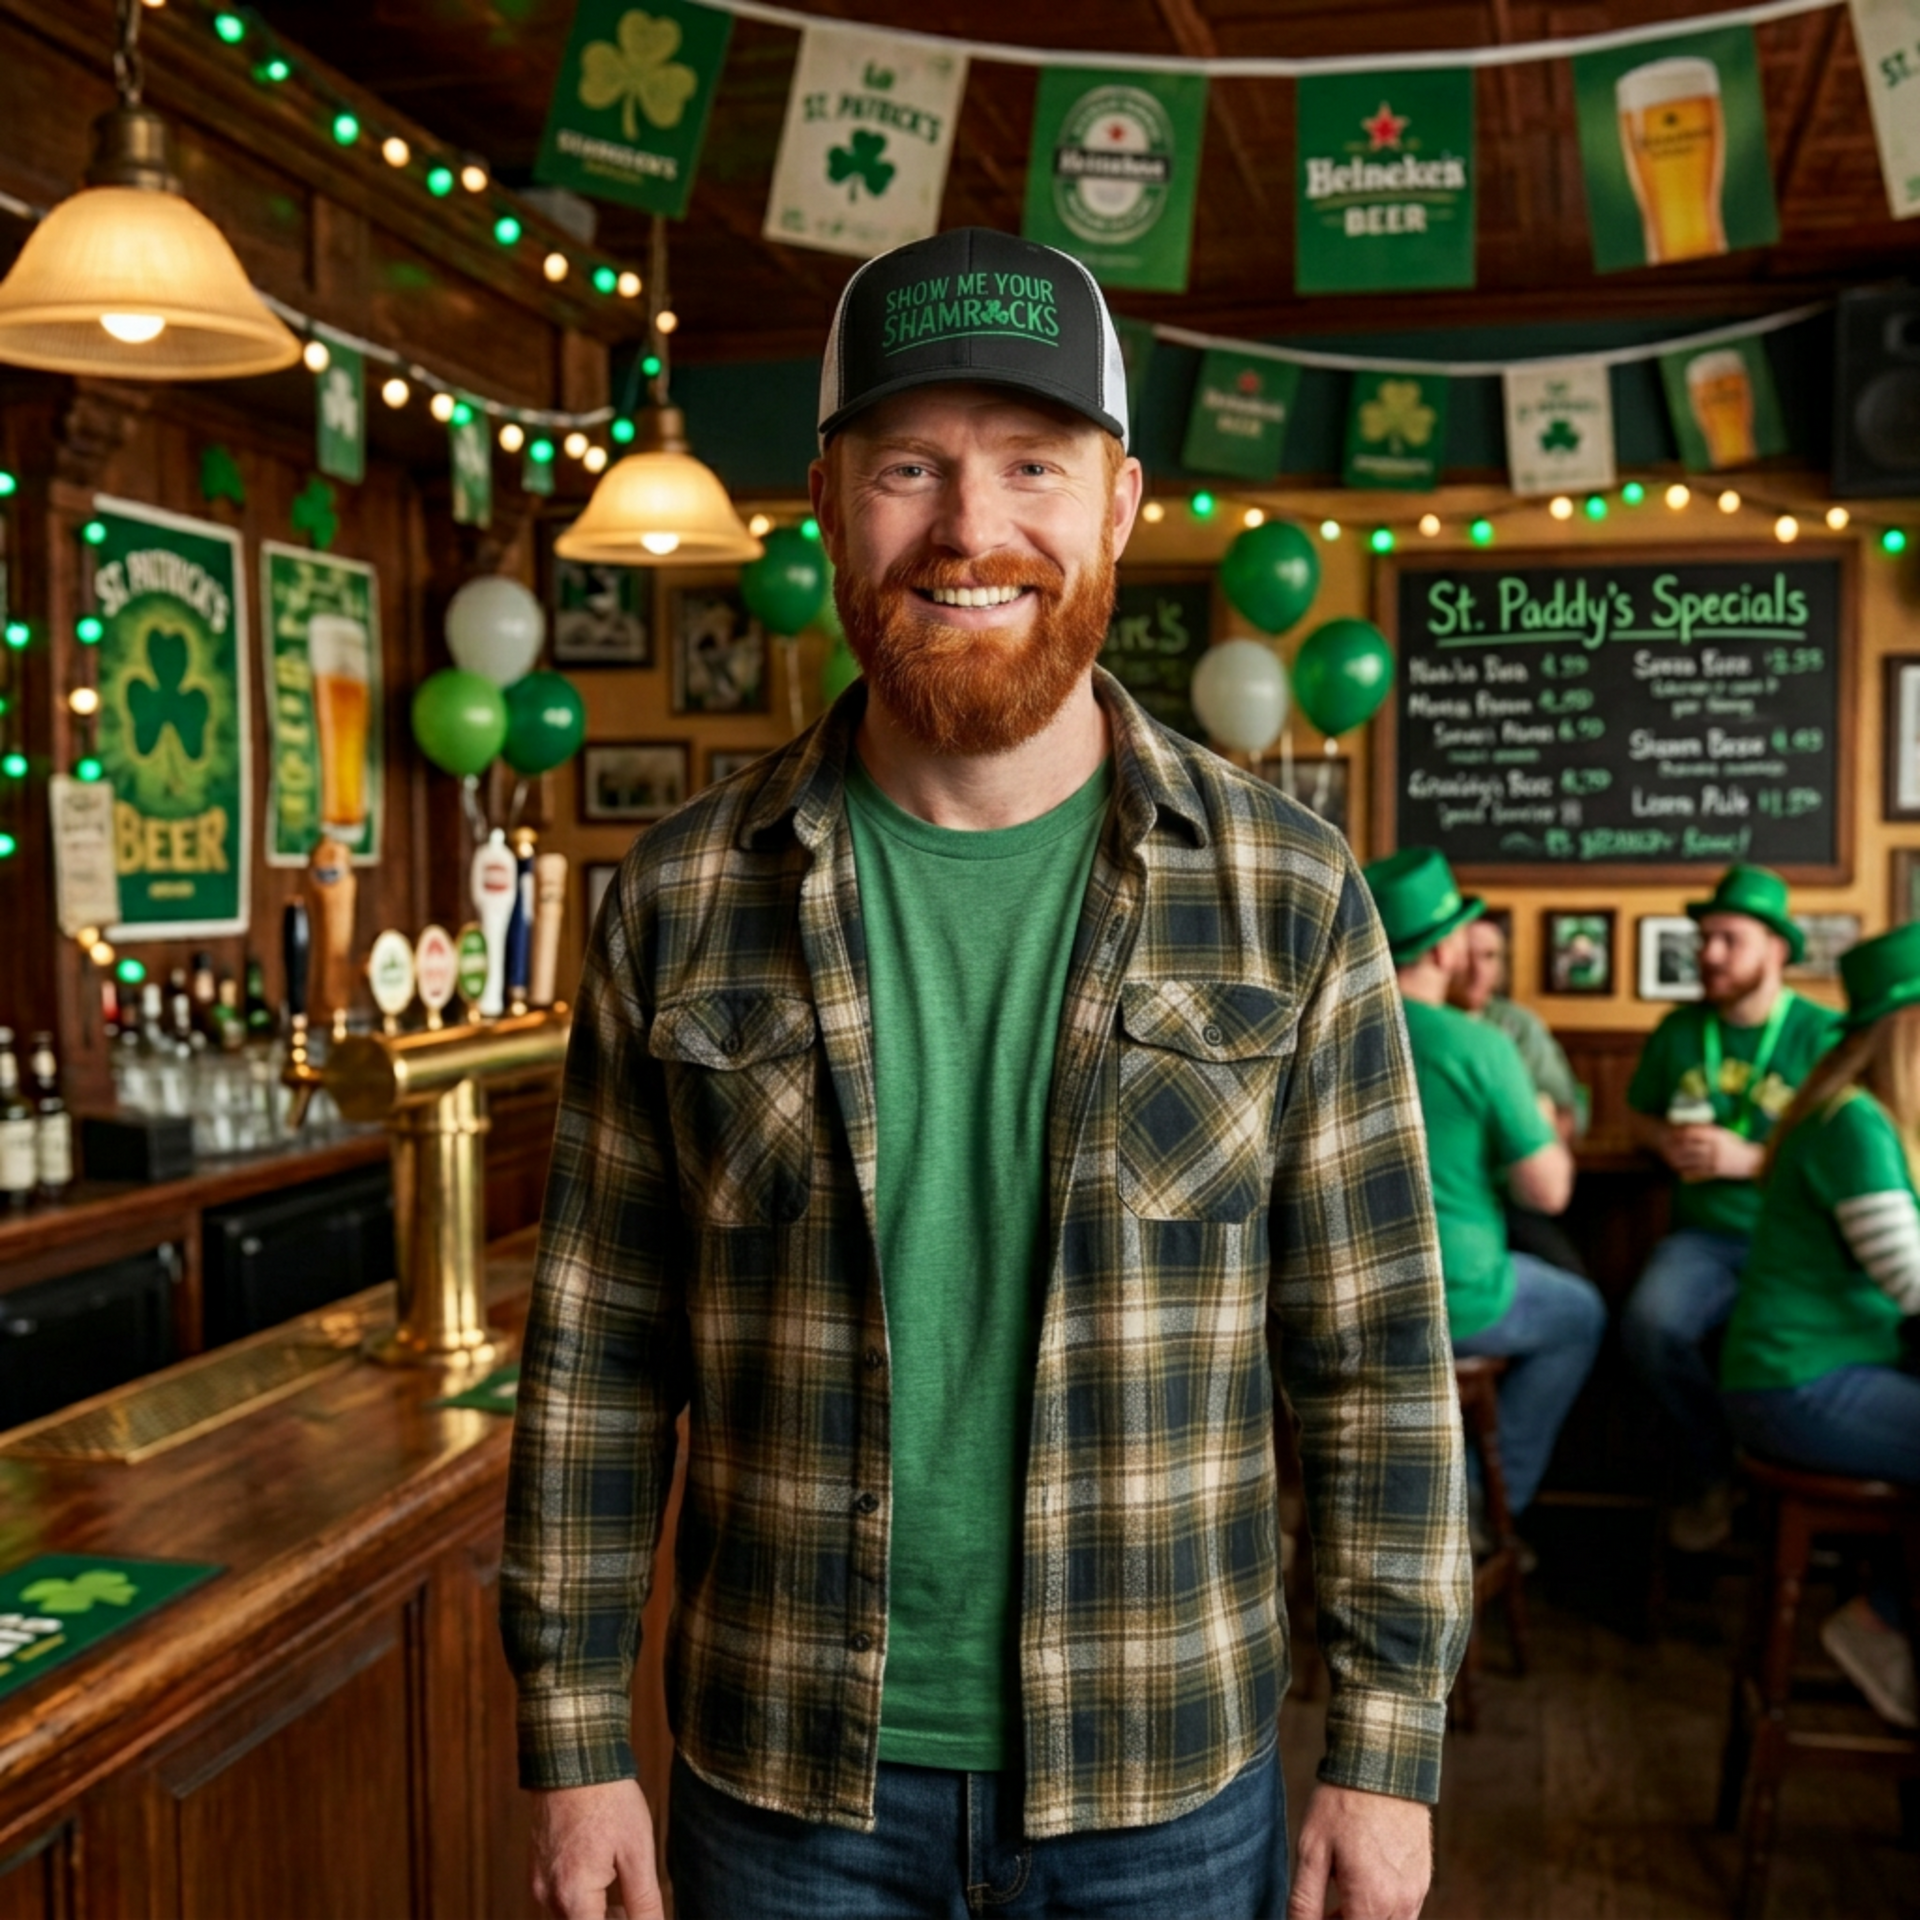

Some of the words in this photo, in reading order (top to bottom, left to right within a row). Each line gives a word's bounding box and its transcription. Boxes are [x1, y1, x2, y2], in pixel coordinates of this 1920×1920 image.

[1344, 204, 1428, 237] BEER
[886, 276, 950, 314] SHOW
[957, 273, 989, 296] ME
[995, 273, 1055, 304] YOUR
[1428, 580, 1486, 635] St.
[1498, 577, 1636, 649] Paddy's
[1651, 572, 1809, 645] Specials
[113, 799, 229, 875] BEER
